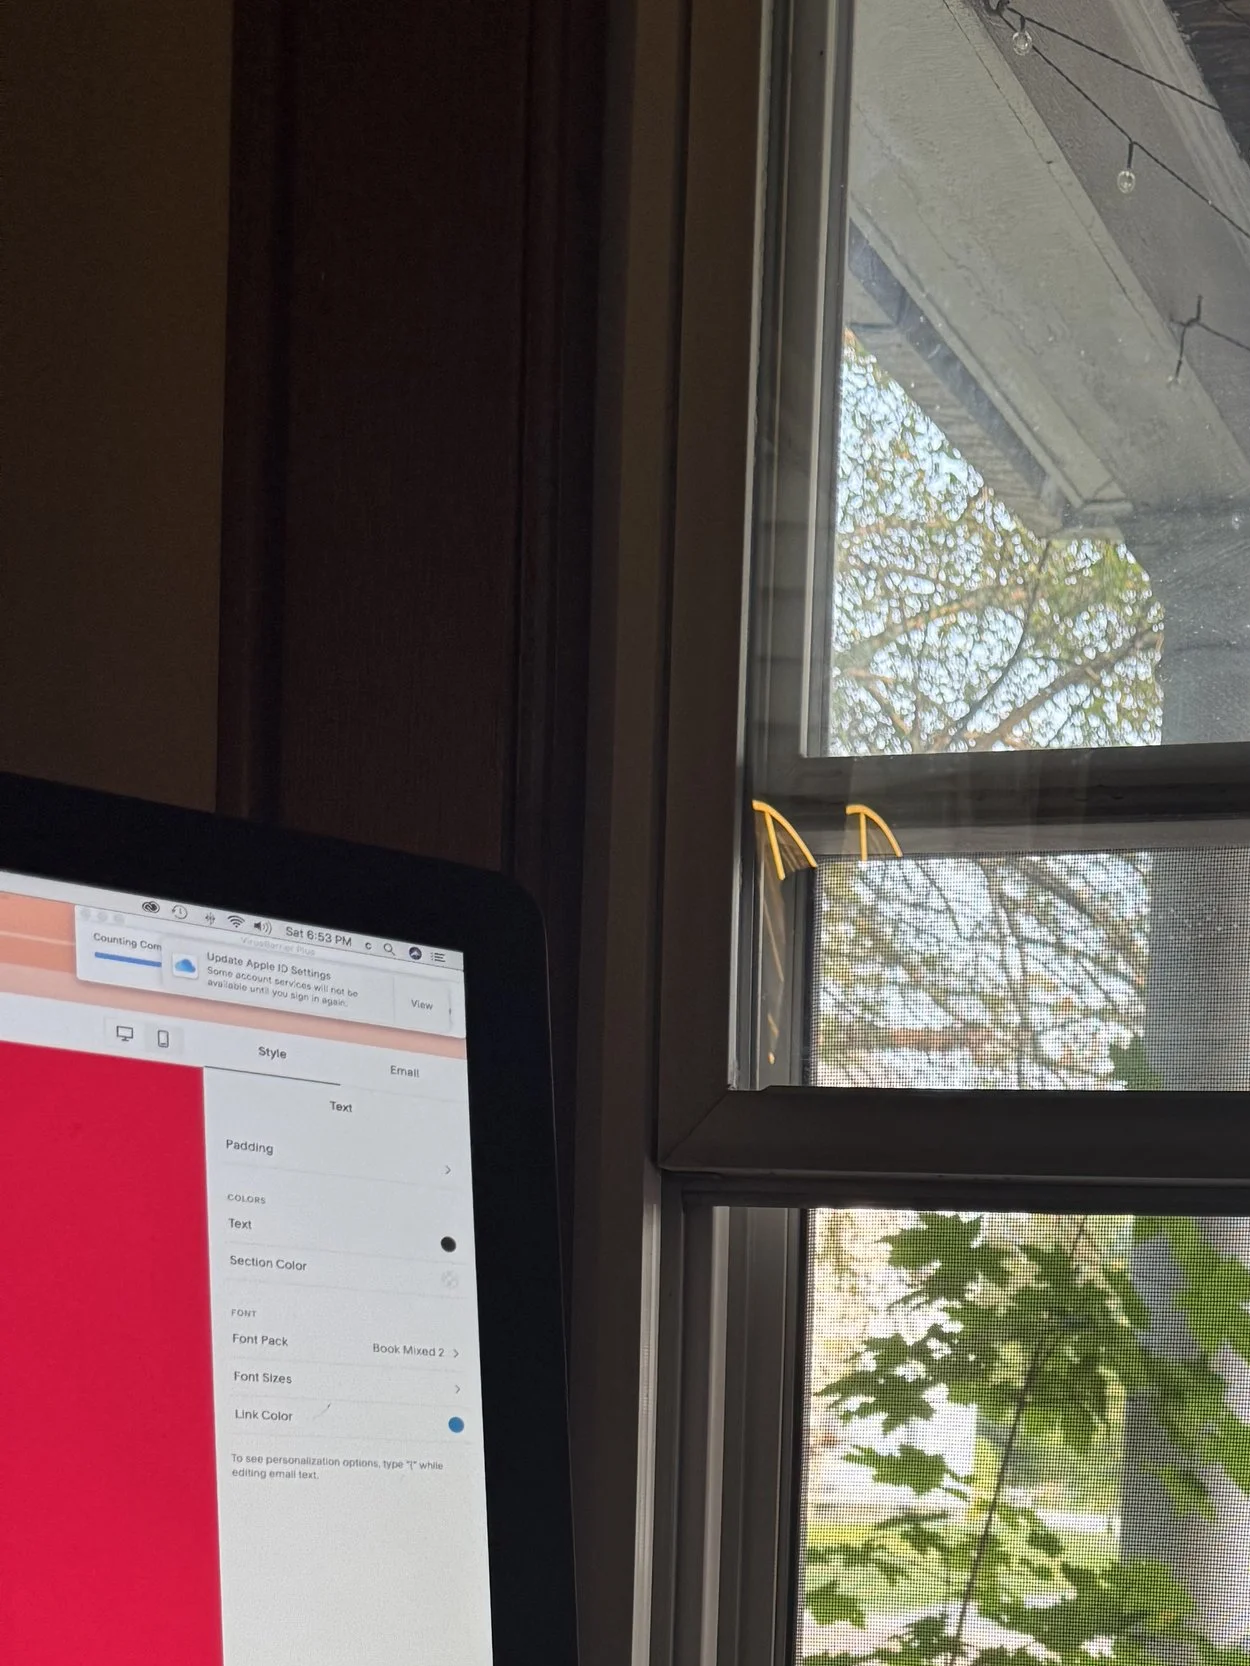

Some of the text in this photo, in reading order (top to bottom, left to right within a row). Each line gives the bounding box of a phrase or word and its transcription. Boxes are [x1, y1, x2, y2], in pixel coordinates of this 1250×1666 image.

[93, 932, 137, 949] Counting
[285, 926, 304, 939] Sat
[307, 931, 332, 944] 6:53
[335, 936, 352, 947] PM
[207, 951, 332, 981] Update Apple ID Settings
[207, 966, 359, 998] Some account services will not be
[207, 978, 348, 1008] available until you sign in again.
[411, 999, 434, 1011] View
[258, 1046, 287, 1060] Style
[390, 1065, 420, 1078] Email
[329, 1100, 353, 1113] Text
[226, 1139, 274, 1156] Padding
[227, 1193, 267, 1205] COLORS
[228, 1218, 252, 1230] Text
[230, 1255, 307, 1272] Section Color
[231, 1309, 257, 1318] FONT
[232, 1333, 289, 1347] Font Pack
[372, 1343, 445, 1358] Book Mixed 2
[233, 1371, 293, 1385] Font Sizes
[235, 1409, 293, 1421] Link Color
[232, 1453, 243, 1463] To
[245, 1456, 264, 1464] see
[265, 1454, 340, 1466] personalization
[342, 1458, 381, 1470] options,
[383, 1460, 404, 1471] type
[419, 1460, 444, 1471] while
[232, 1468, 319, 1480] editing email text.
